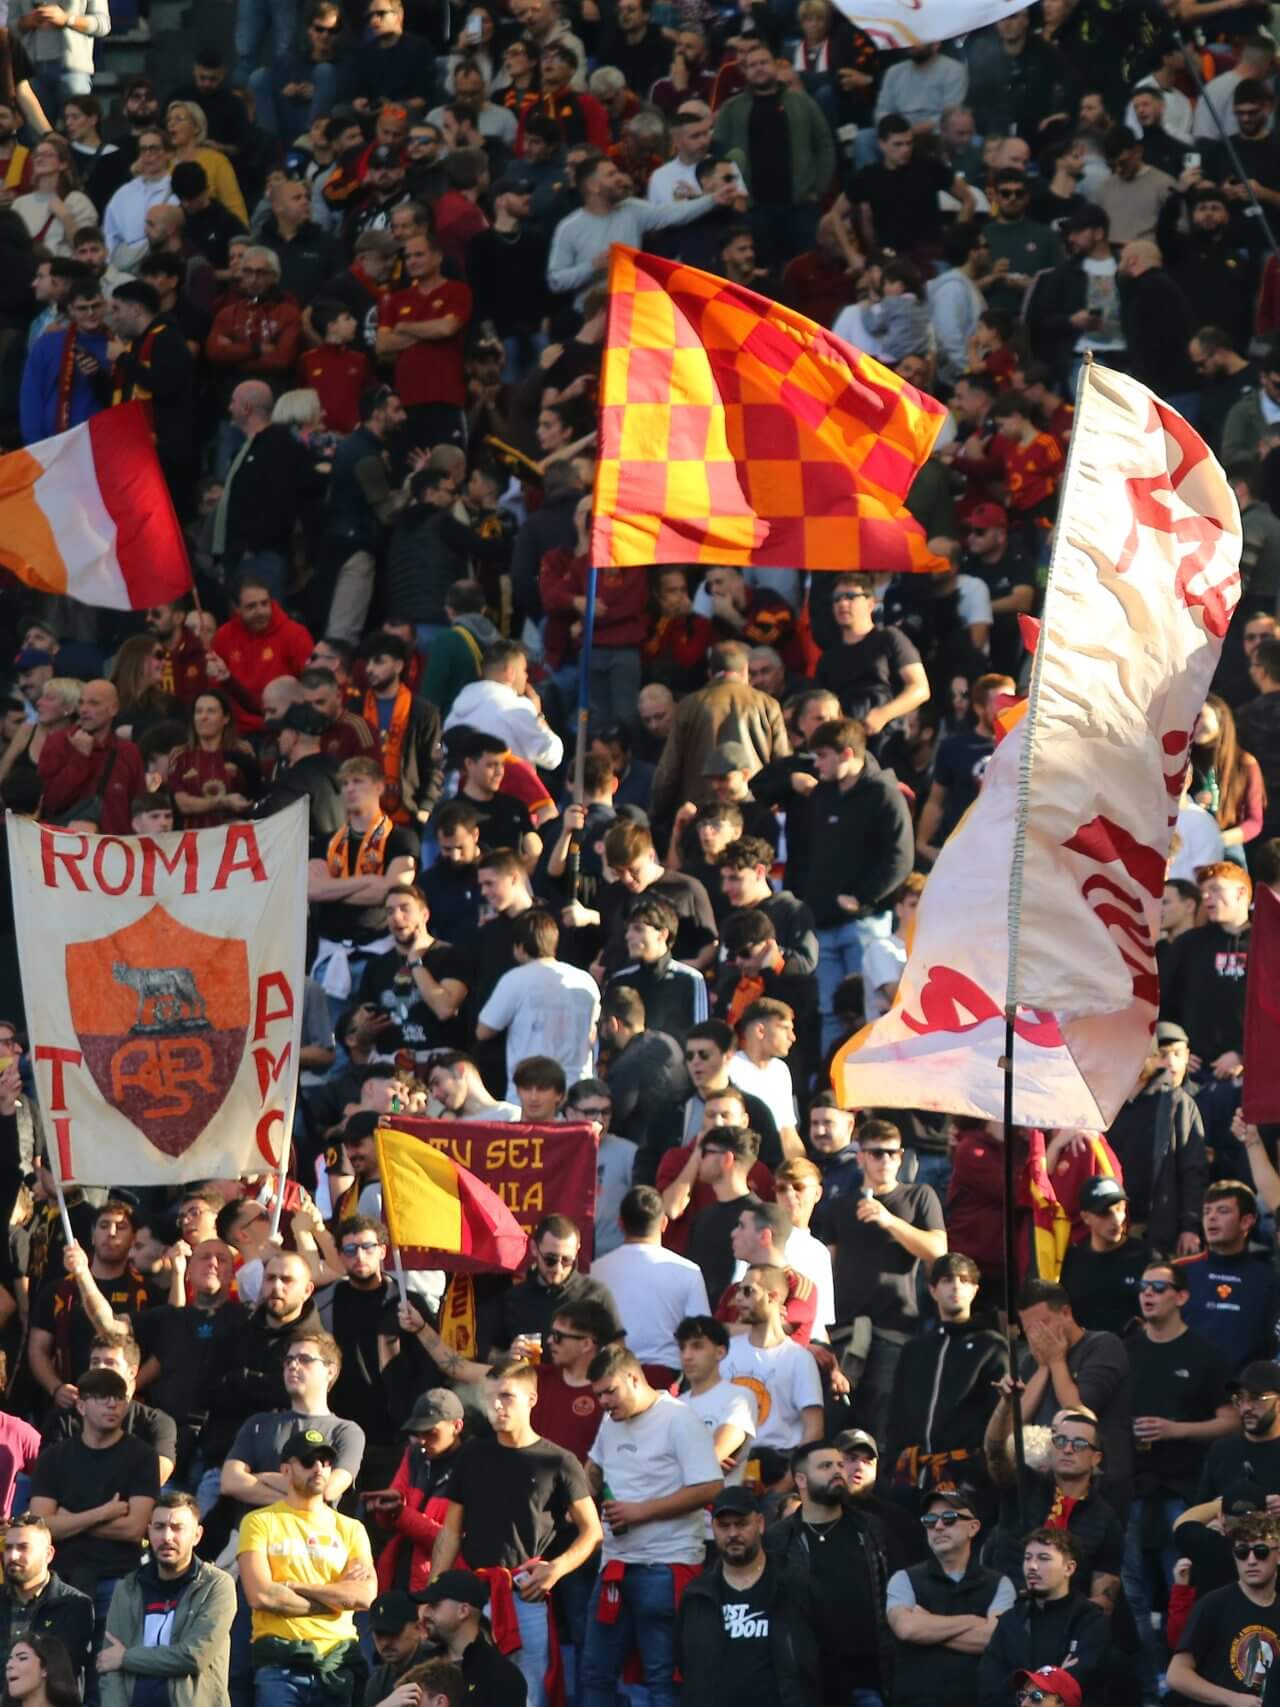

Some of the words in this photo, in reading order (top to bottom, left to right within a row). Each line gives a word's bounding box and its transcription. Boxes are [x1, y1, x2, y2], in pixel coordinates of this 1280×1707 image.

[39, 823, 268, 897] ROMA
[34, 1045, 83, 1182] TI
[485, 1138, 545, 1169] SEI
